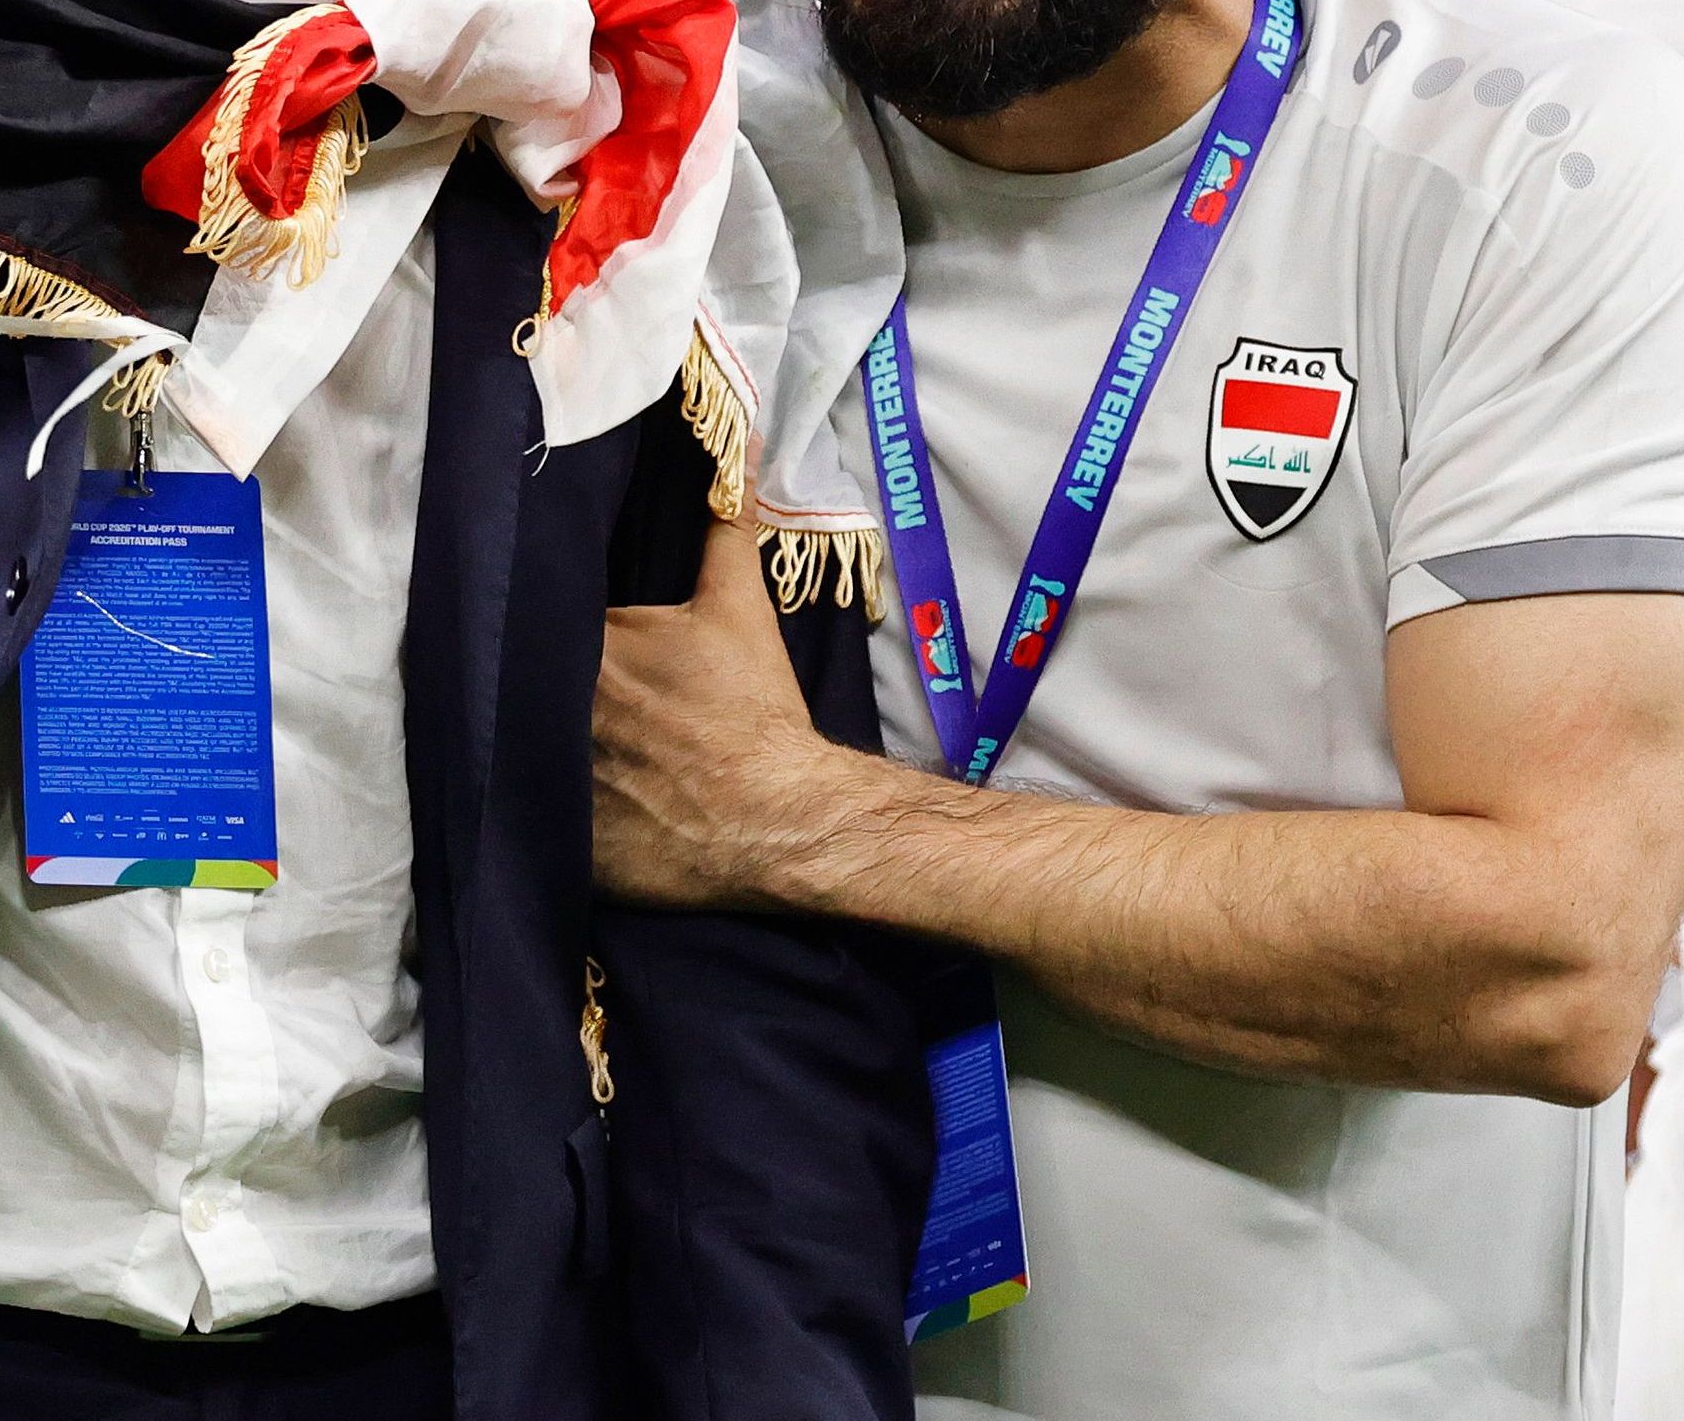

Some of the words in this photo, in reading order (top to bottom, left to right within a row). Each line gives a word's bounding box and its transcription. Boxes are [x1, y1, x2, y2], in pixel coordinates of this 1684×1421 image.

[1244, 352, 1326, 380] IRAQ
[1065, 286, 1180, 512] MONTERREY
[868, 326, 927, 531] MONTERRE
[90, 523, 107, 532] CUP
[137, 524, 177, 533] PLAY-OFF
[178, 525, 235, 535] TOURNAMENT
[90, 535, 162, 546] ACCREDITATION
[162, 537, 188, 547] PASS
